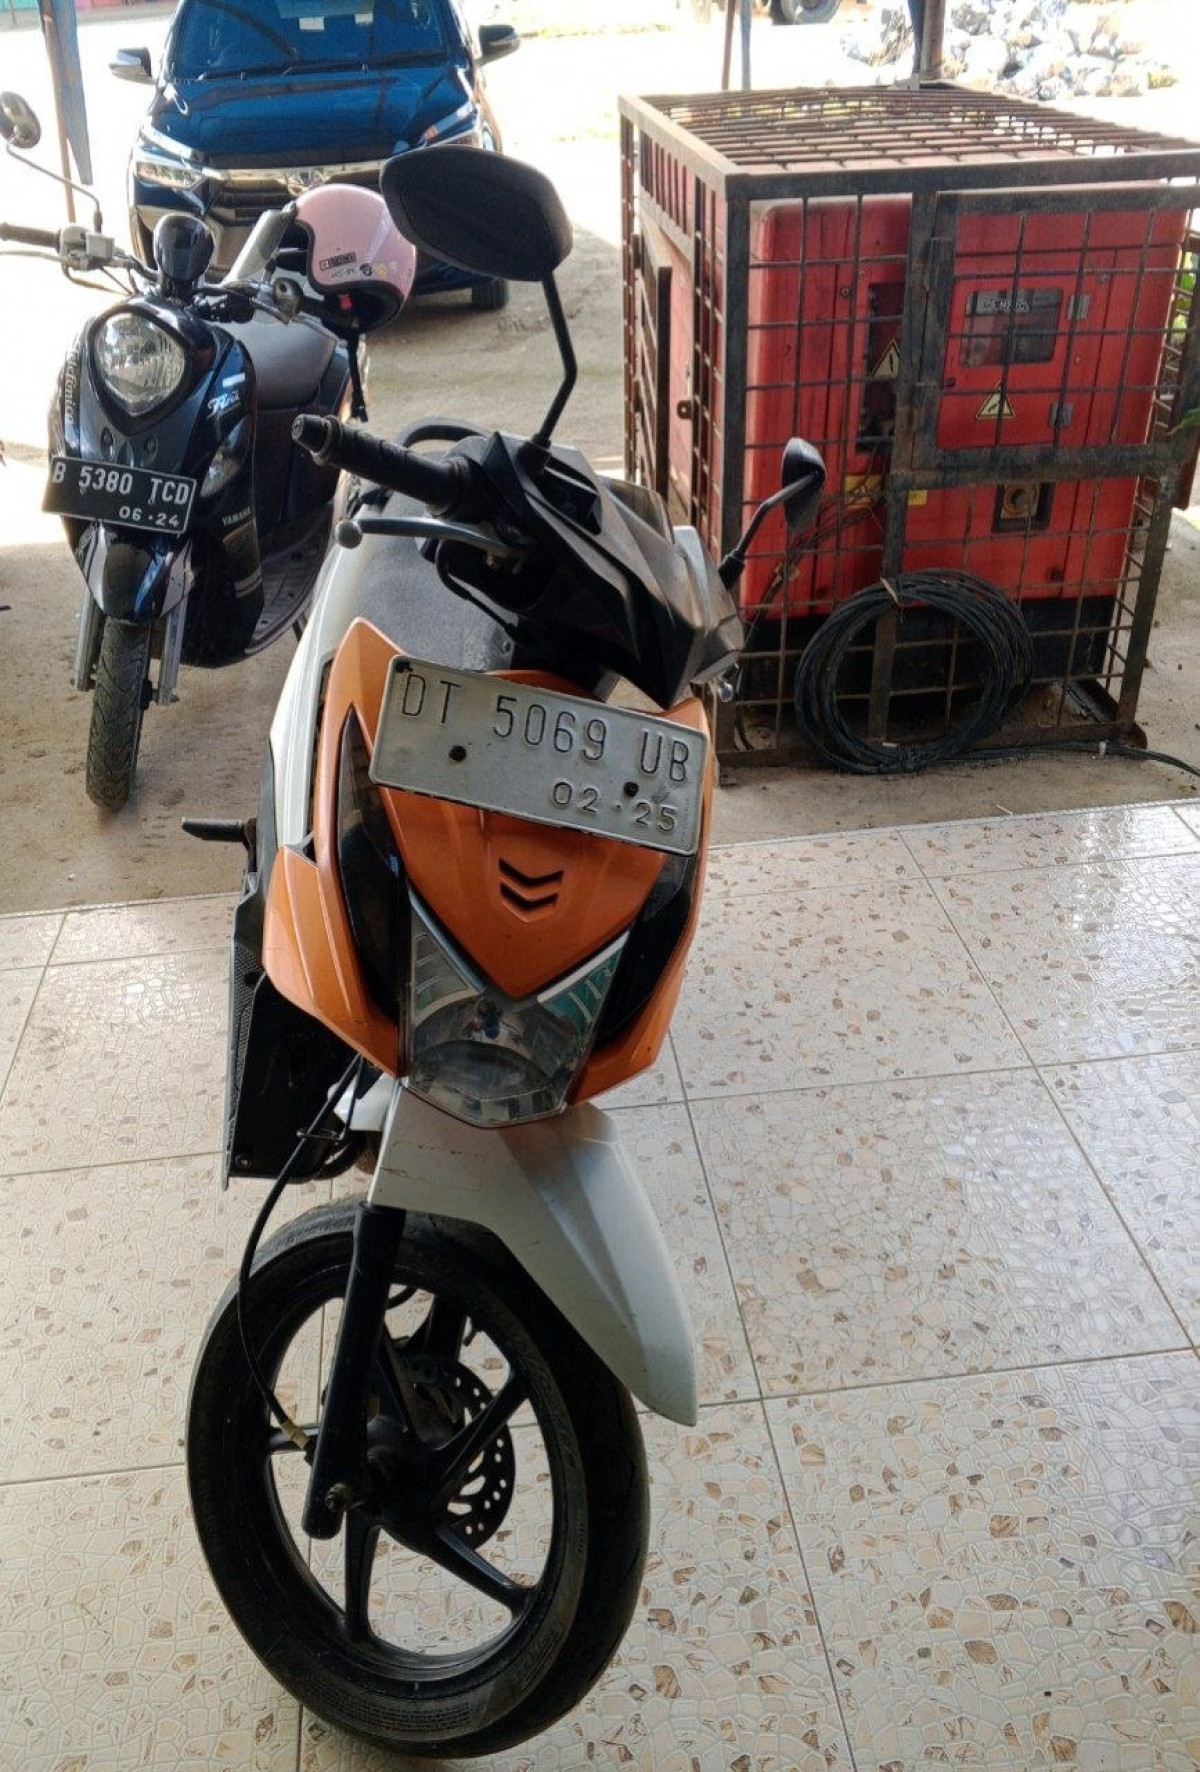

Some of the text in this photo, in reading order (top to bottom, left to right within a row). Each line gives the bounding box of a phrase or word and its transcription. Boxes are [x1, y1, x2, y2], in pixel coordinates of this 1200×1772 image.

[52, 461, 190, 505] B 5380 TCD
[402, 673, 690, 782] DT 5069 UB
